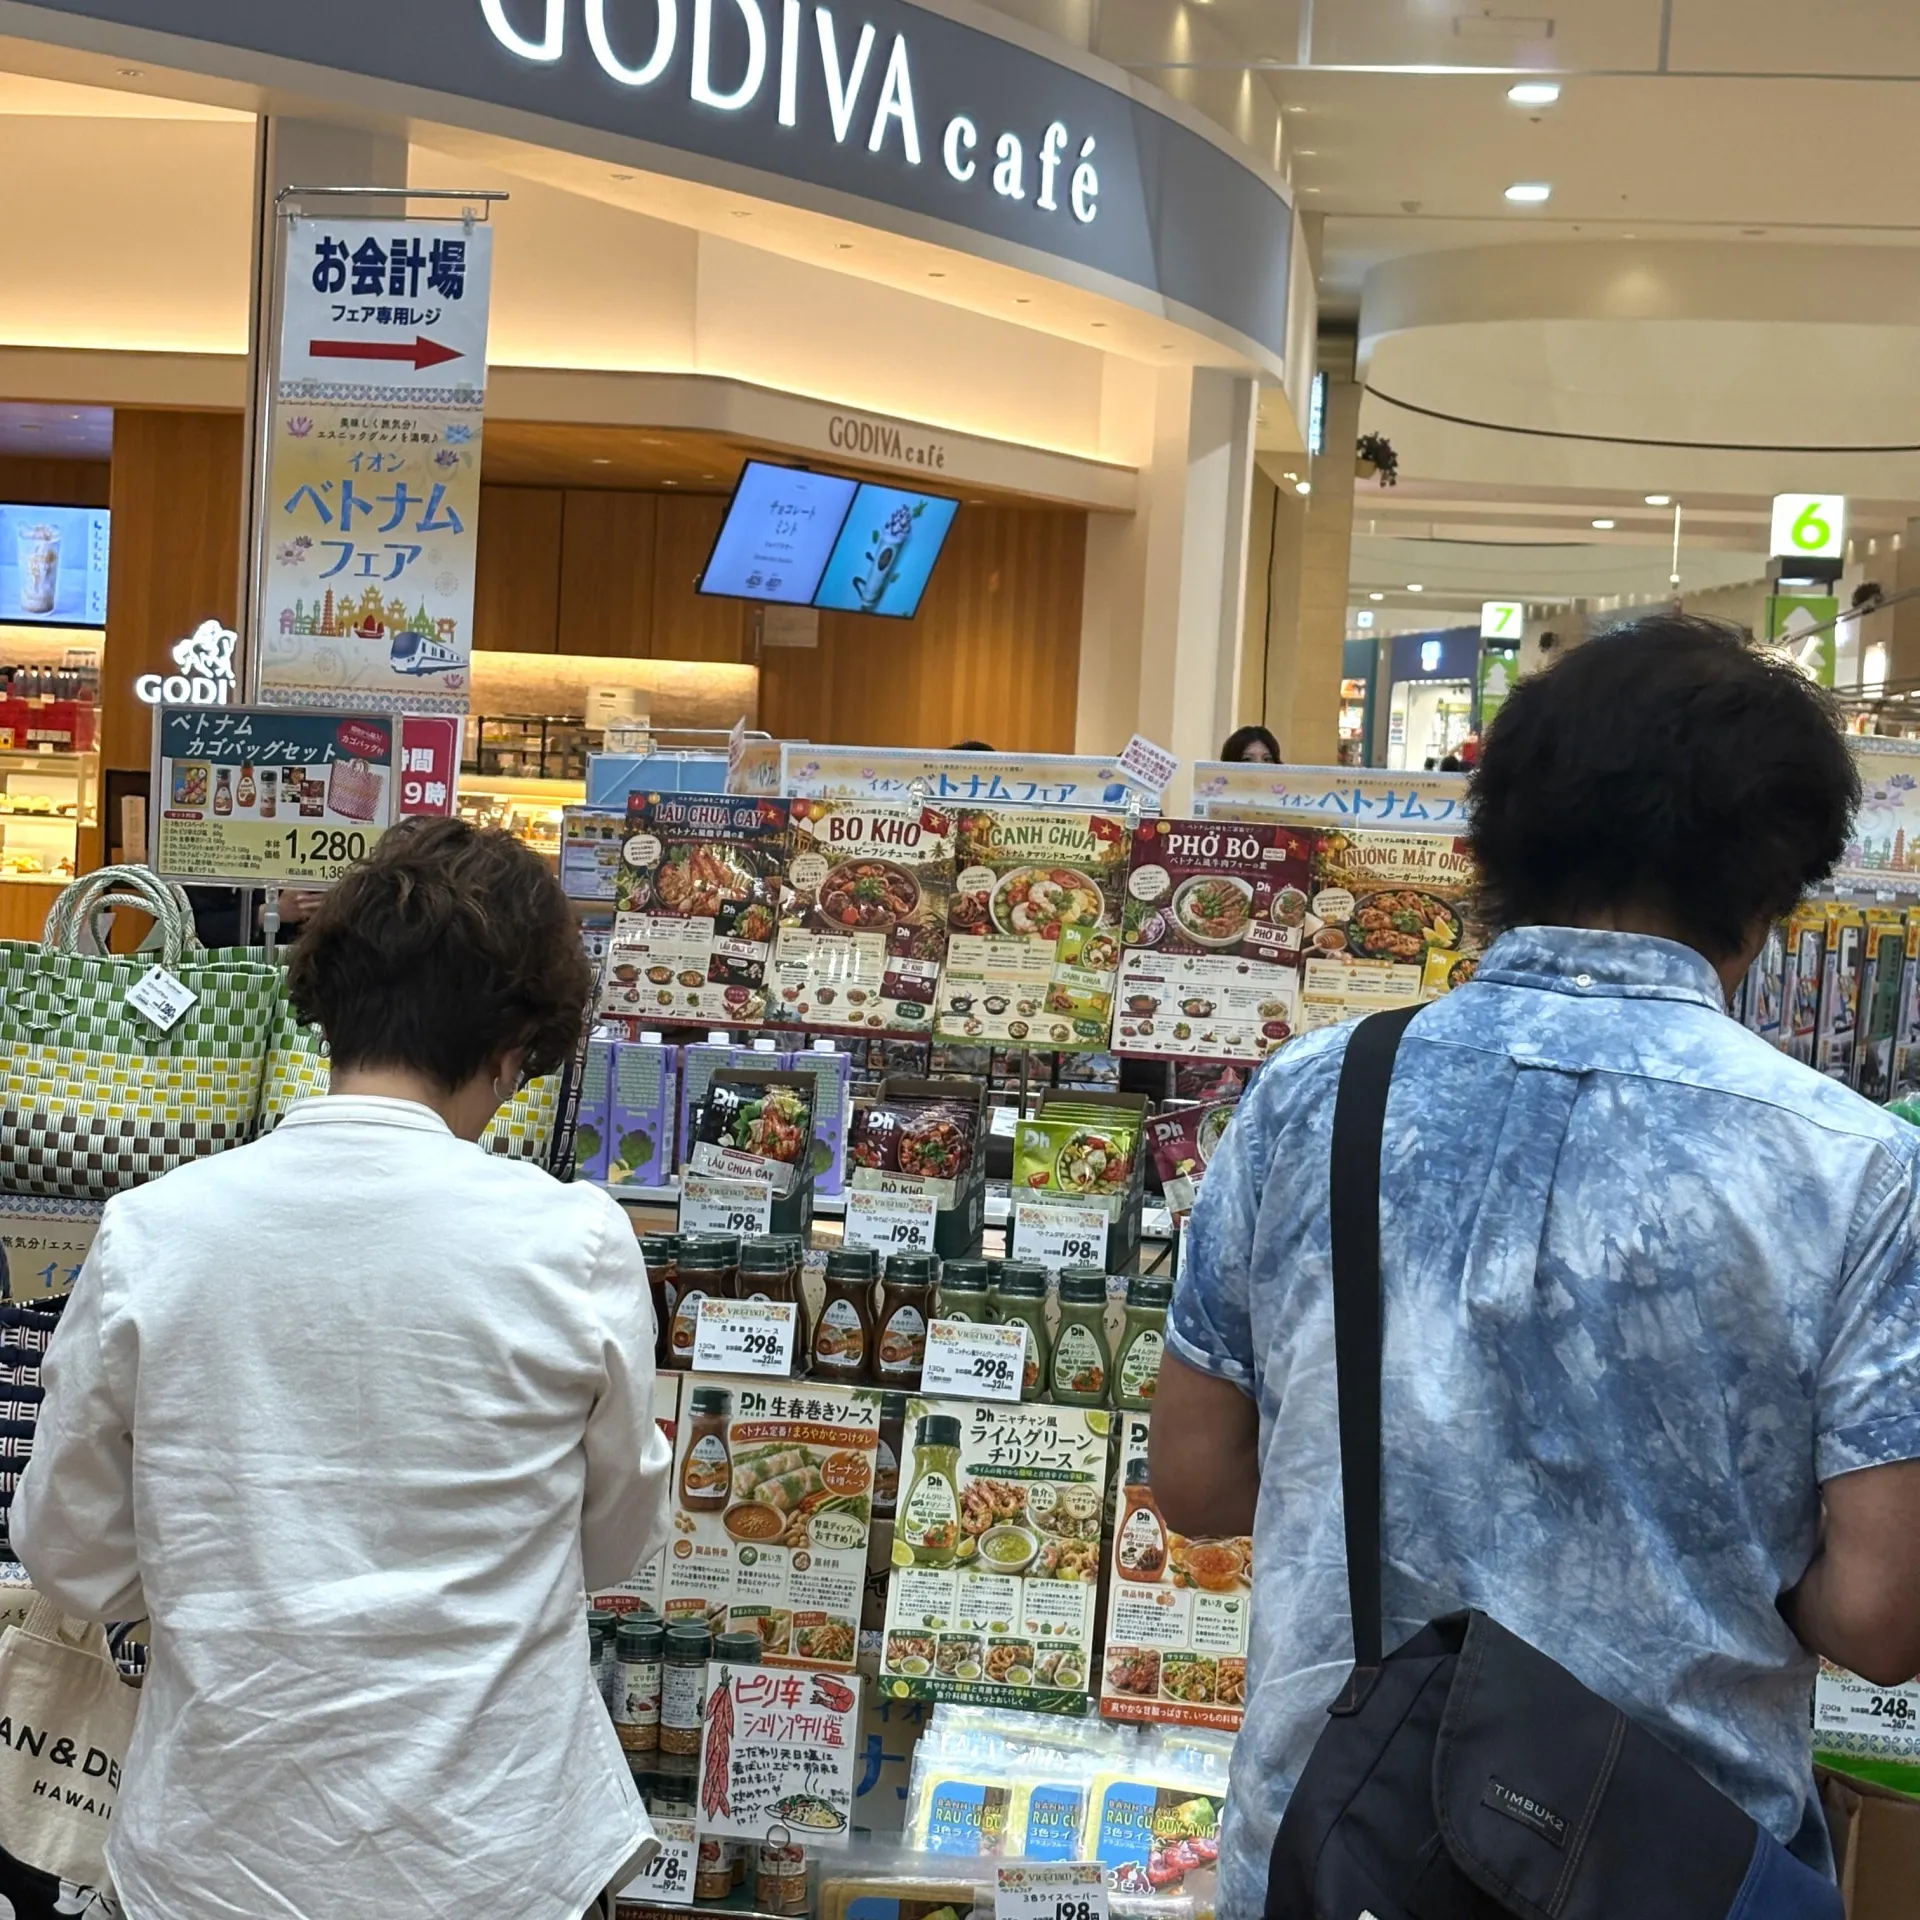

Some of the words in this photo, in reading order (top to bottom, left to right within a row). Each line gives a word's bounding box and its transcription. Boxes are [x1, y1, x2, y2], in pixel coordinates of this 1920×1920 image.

[942, 115, 1100, 224] café
[312, 236, 466, 300] お会計場
[331, 305, 441, 325] フェア専用レジ
[829, 416, 902, 459] GODIVA
[905, 444, 945, 469] café
[347, 451, 406, 472] イオン
[284, 479, 464, 535] ベトナム
[1790, 502, 1831, 550] 6
[319, 540, 423, 581] フェア
[1493, 608, 1514, 632] 7
[135, 673, 236, 705] GODI
[171, 714, 253, 736] ベトナム
[185, 736, 338, 763] カゴバッグセット
[404, 782, 447, 807] 9時
[869, 778, 904, 791] イオン
[1280, 793, 1316, 807] イオン
[688, 805, 730, 825] CHUA
[734, 809, 764, 828] CAY
[871, 818, 922, 848] KHO
[991, 826, 1043, 847] CANH
[1048, 827, 1097, 852] CHUA
[1225, 835, 1260, 859] BÒ
[1439, 853, 1471, 873] ONG
[1256, 882, 1271, 893] Dh
[713, 1087, 739, 1108] Dh
[868, 1112, 895, 1130] Dh
[1153, 1119, 1183, 1141] Dh
[1024, 1129, 1049, 1150] Dh
[727, 1160, 752, 1176] CHUA
[755, 1168, 774, 1182] CAY
[1071, 1327, 1084, 1337] Dh
[1144, 1333, 1157, 1343] Dh
[742, 1334, 783, 1355] 298円
[972, 1358, 1014, 1381] 298円
[741, 1392, 766, 1411] Dh
[770, 1396, 874, 1425] 生春巻きソース
[976, 1408, 995, 1423] Dh
[998, 1413, 1058, 1427] ニャチャン風
[737, 1426, 872, 1444] ベトナム定番!まろやかなつけダレ
[970, 1425, 1093, 1450] ライムグリーン
[1131, 1423, 1149, 1442] D
[827, 1462, 868, 1475] ピーナッツ
[988, 1449, 1073, 1468] チリソース
[927, 1475, 942, 1486] Dh
[1031, 1487, 1053, 1498] 魚介に
[1137, 1512, 1150, 1521] Dh
[815, 1531, 854, 1544] おすすめ!
[760, 1552, 782, 1563] 使い方
[1200, 1598, 1223, 1609] 使い方
[735, 1674, 805, 1709] ピリ辛
[936, 1692, 1029, 1707] 魚介料理をもっとおいしく。
[1869, 1696, 1916, 1721] 248円
[33, 1780, 111, 1820] HAWAII
[1494, 1783, 1564, 1832] TIMBUK2
[935, 1807, 962, 1824] RAU
[1032, 1811, 1059, 1826] RAU
[1106, 1810, 1133, 1826] RAU
[1156, 1817, 1183, 1834] DUY
[1186, 1823, 1216, 1840] ANH
[1023, 1893, 1099, 1903] 3色ライスペーパー
